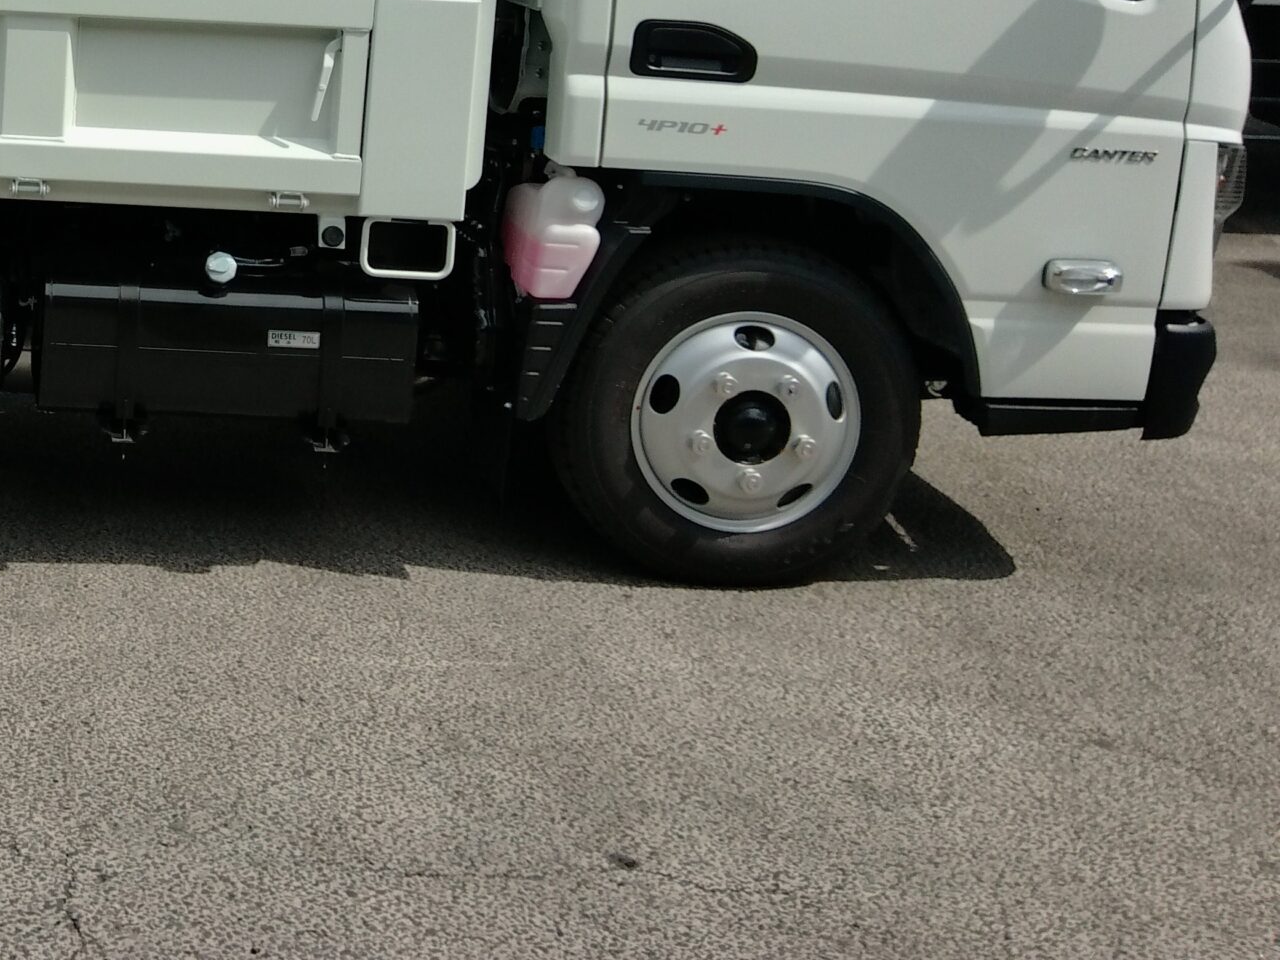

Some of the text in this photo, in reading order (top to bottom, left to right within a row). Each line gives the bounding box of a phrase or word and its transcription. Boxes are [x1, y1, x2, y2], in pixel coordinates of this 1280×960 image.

[1070, 147, 1158, 164] CANTER
[271, 332, 297, 340] DIESEL
[302, 335, 317, 344] 70L
